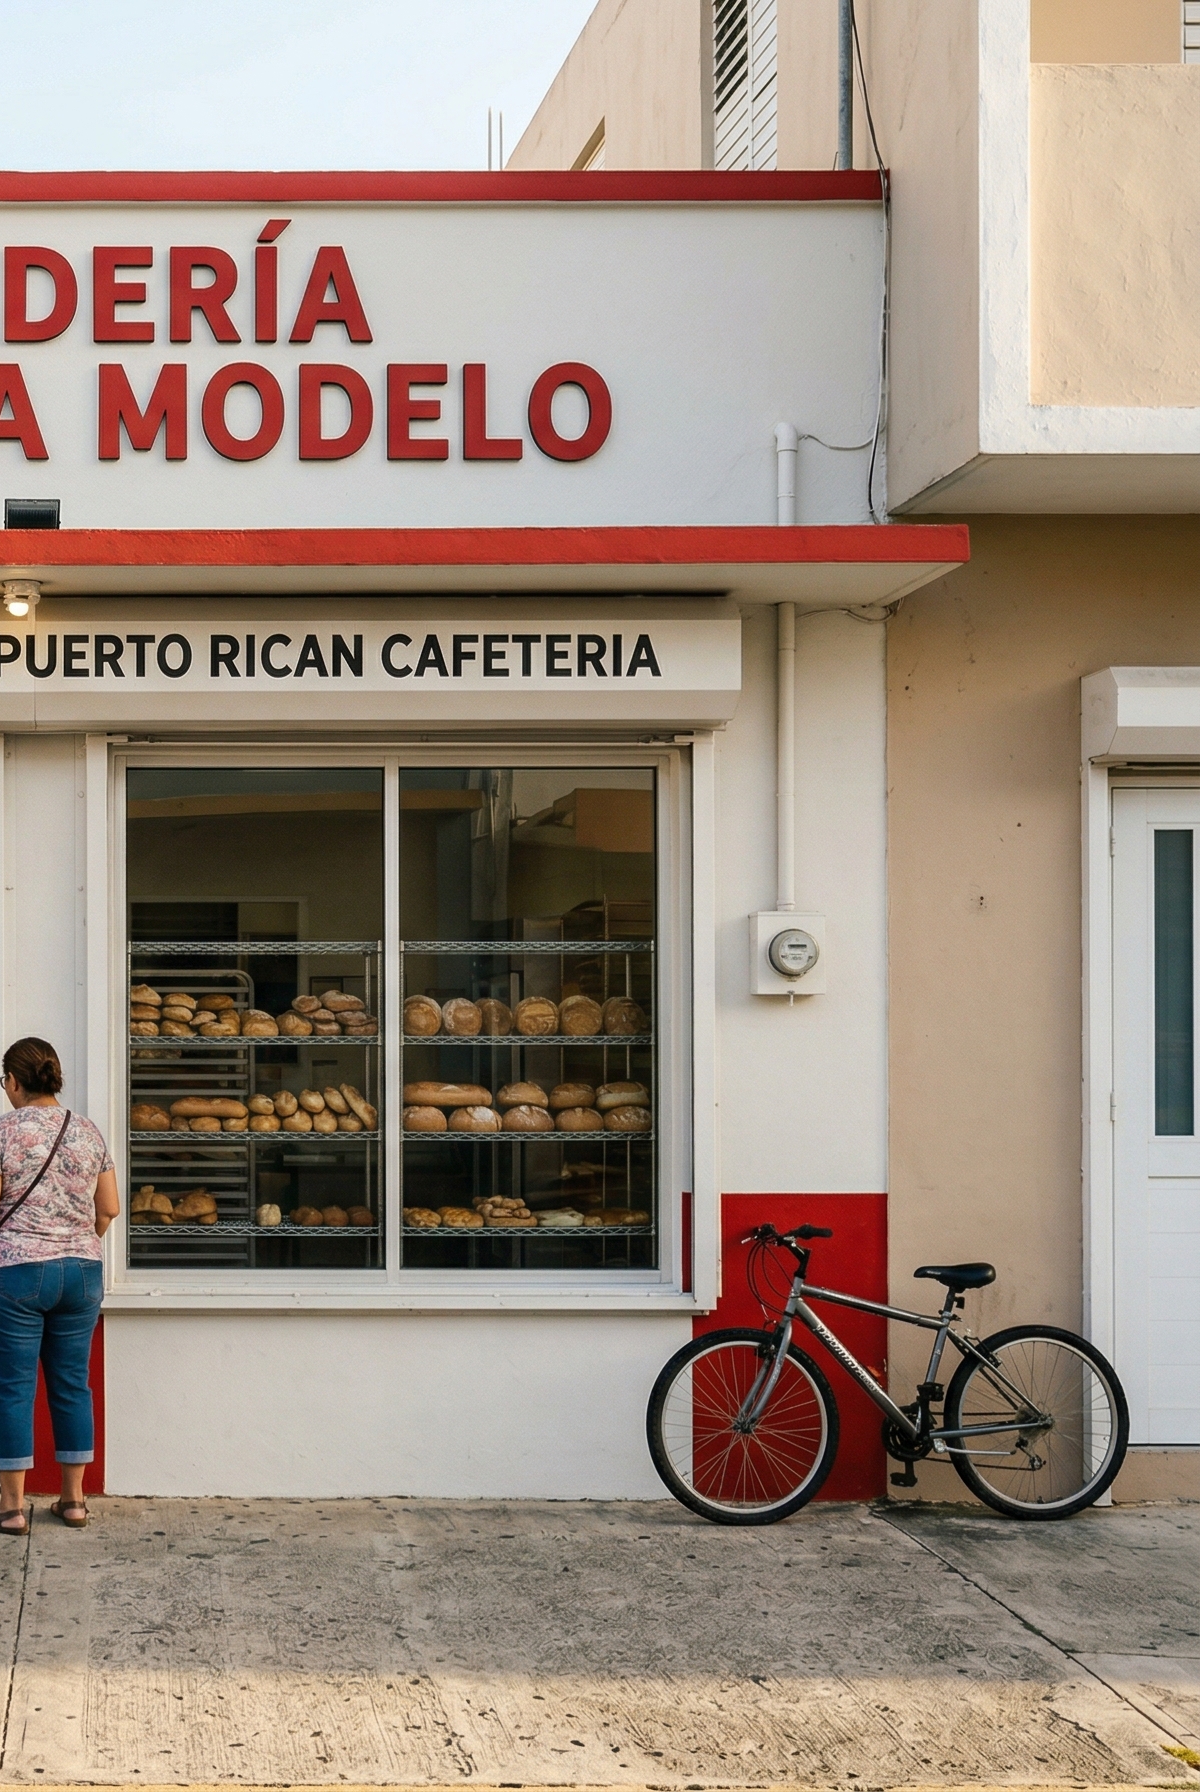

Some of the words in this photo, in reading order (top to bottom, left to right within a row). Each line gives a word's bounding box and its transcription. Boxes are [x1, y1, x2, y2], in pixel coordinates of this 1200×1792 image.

[97, 360, 613, 462] MODELO
[210, 633, 363, 679] RICAN
[381, 633, 662, 679] CAFETERIA
